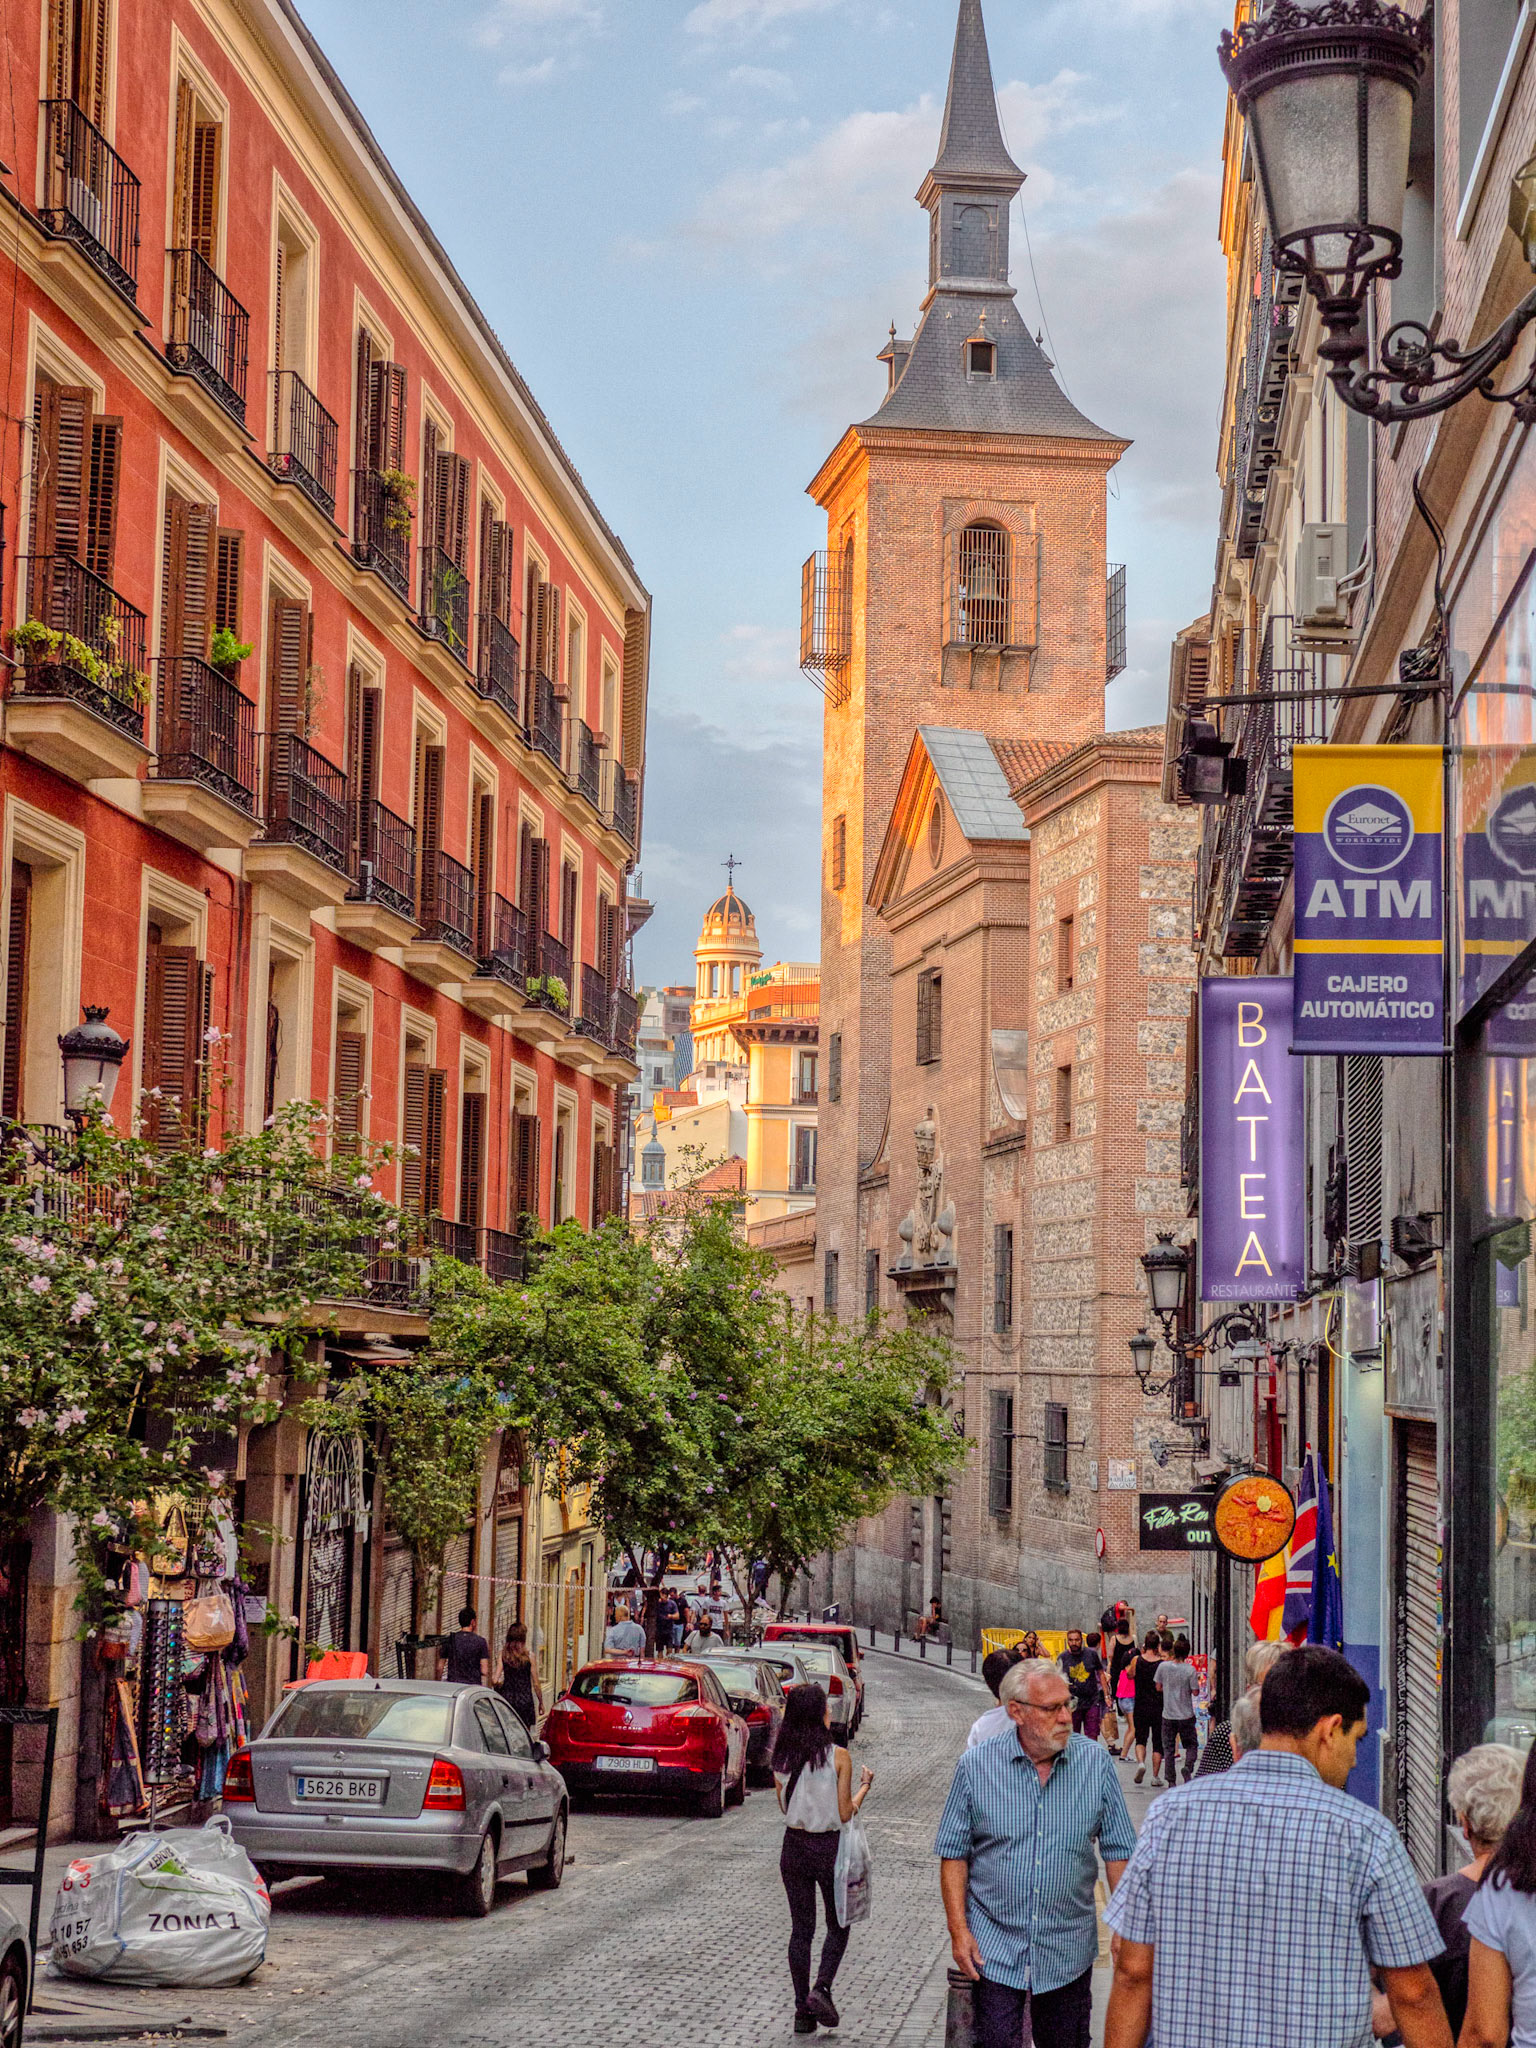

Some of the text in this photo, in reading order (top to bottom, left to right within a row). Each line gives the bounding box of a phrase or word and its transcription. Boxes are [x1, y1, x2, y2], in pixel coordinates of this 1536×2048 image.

[1348, 813, 1391, 825] Euronet
[1303, 879, 1433, 919] ATM
[1327, 975, 1408, 993] CAJERO
[1299, 996, 1436, 1019] AUTOMÁTICO
[1233, 1001, 1273, 1277] BATEA
[1210, 1284, 1298, 1297] RESTAURANTE
[607, 1758, 631, 1769] 7909
[307, 1780, 377, 1797] 5626 BKB
[76, 1917, 92, 1936] 57
[148, 1911, 241, 1933] ZONA 1
